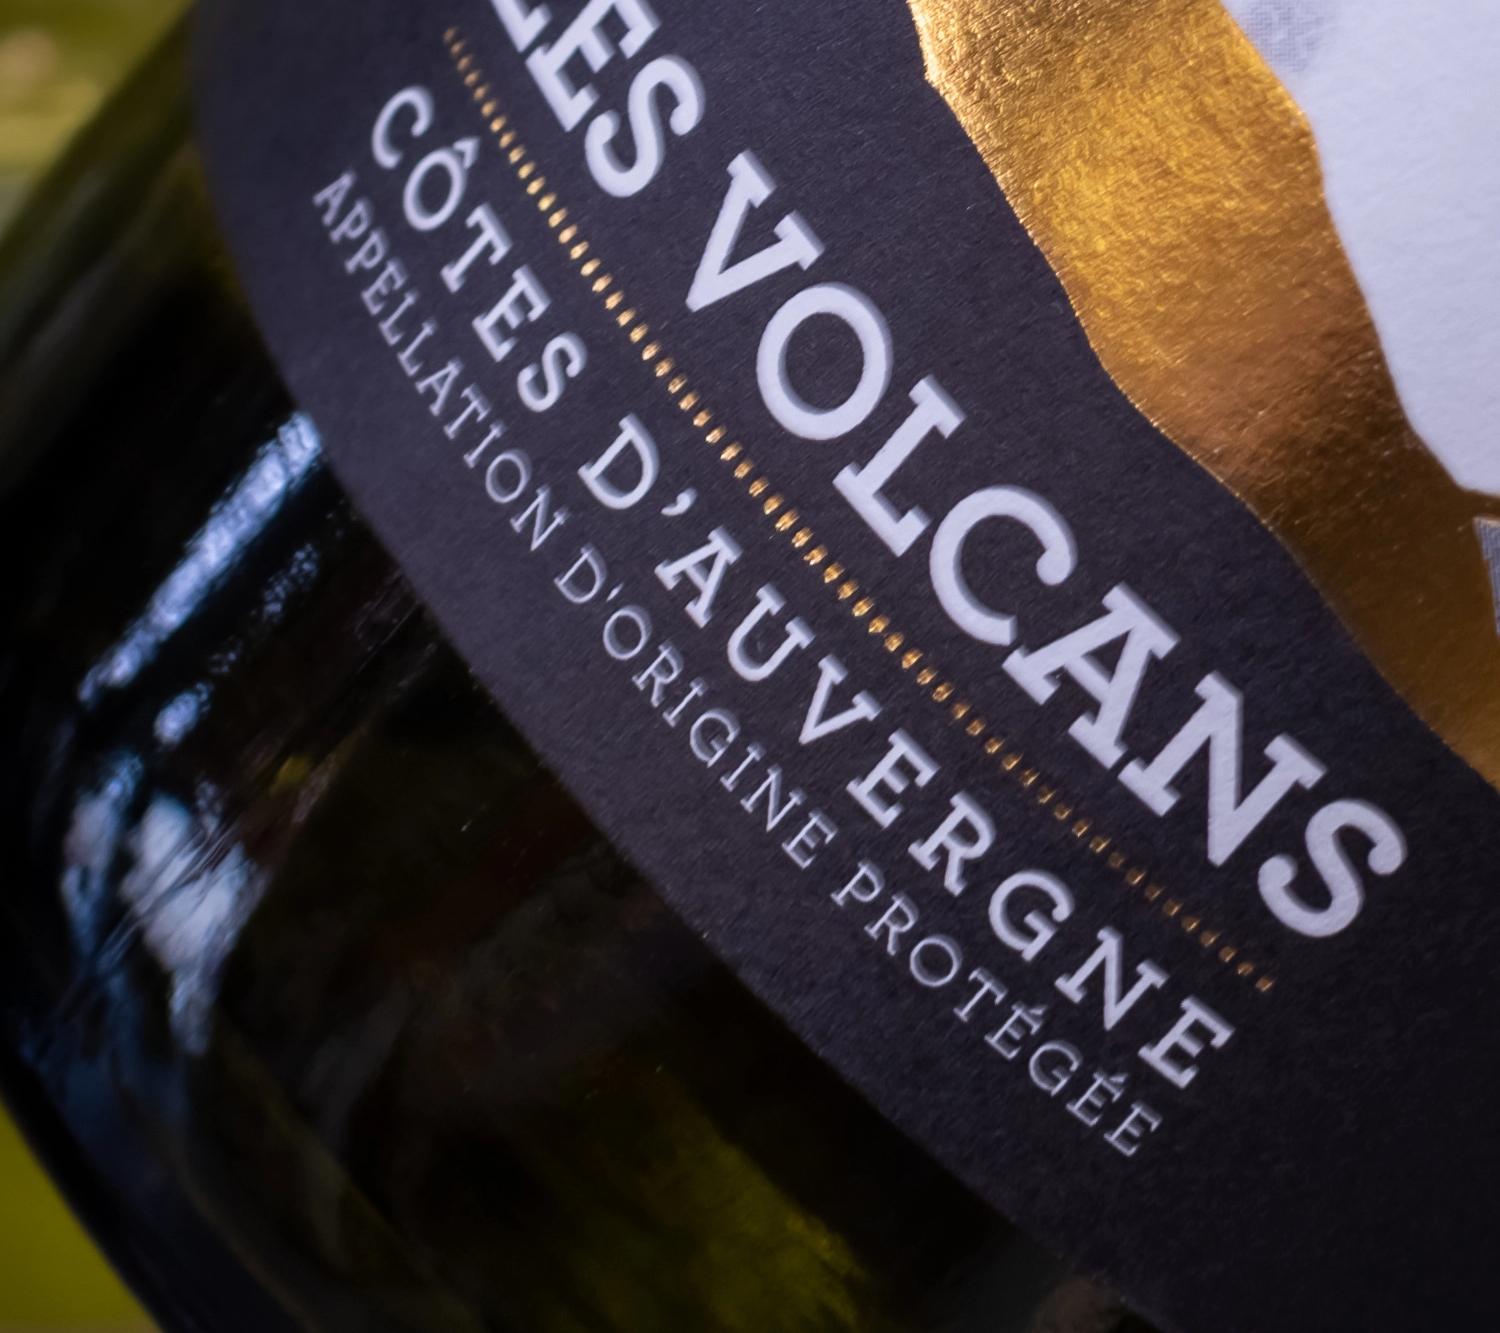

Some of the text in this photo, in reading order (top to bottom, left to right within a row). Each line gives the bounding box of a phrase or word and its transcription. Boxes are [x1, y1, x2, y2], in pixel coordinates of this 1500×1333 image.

[312, 169, 573, 552] APPELLATION
[553, 545, 839, 871] D'ORIGINE
[829, 859, 1162, 1157] PROTÉGÉE
[370, 86, 588, 414] CÔTES
[577, 413, 1234, 1090] D’AUVERGNE
[685, 150, 1406, 938] VOLCANS
